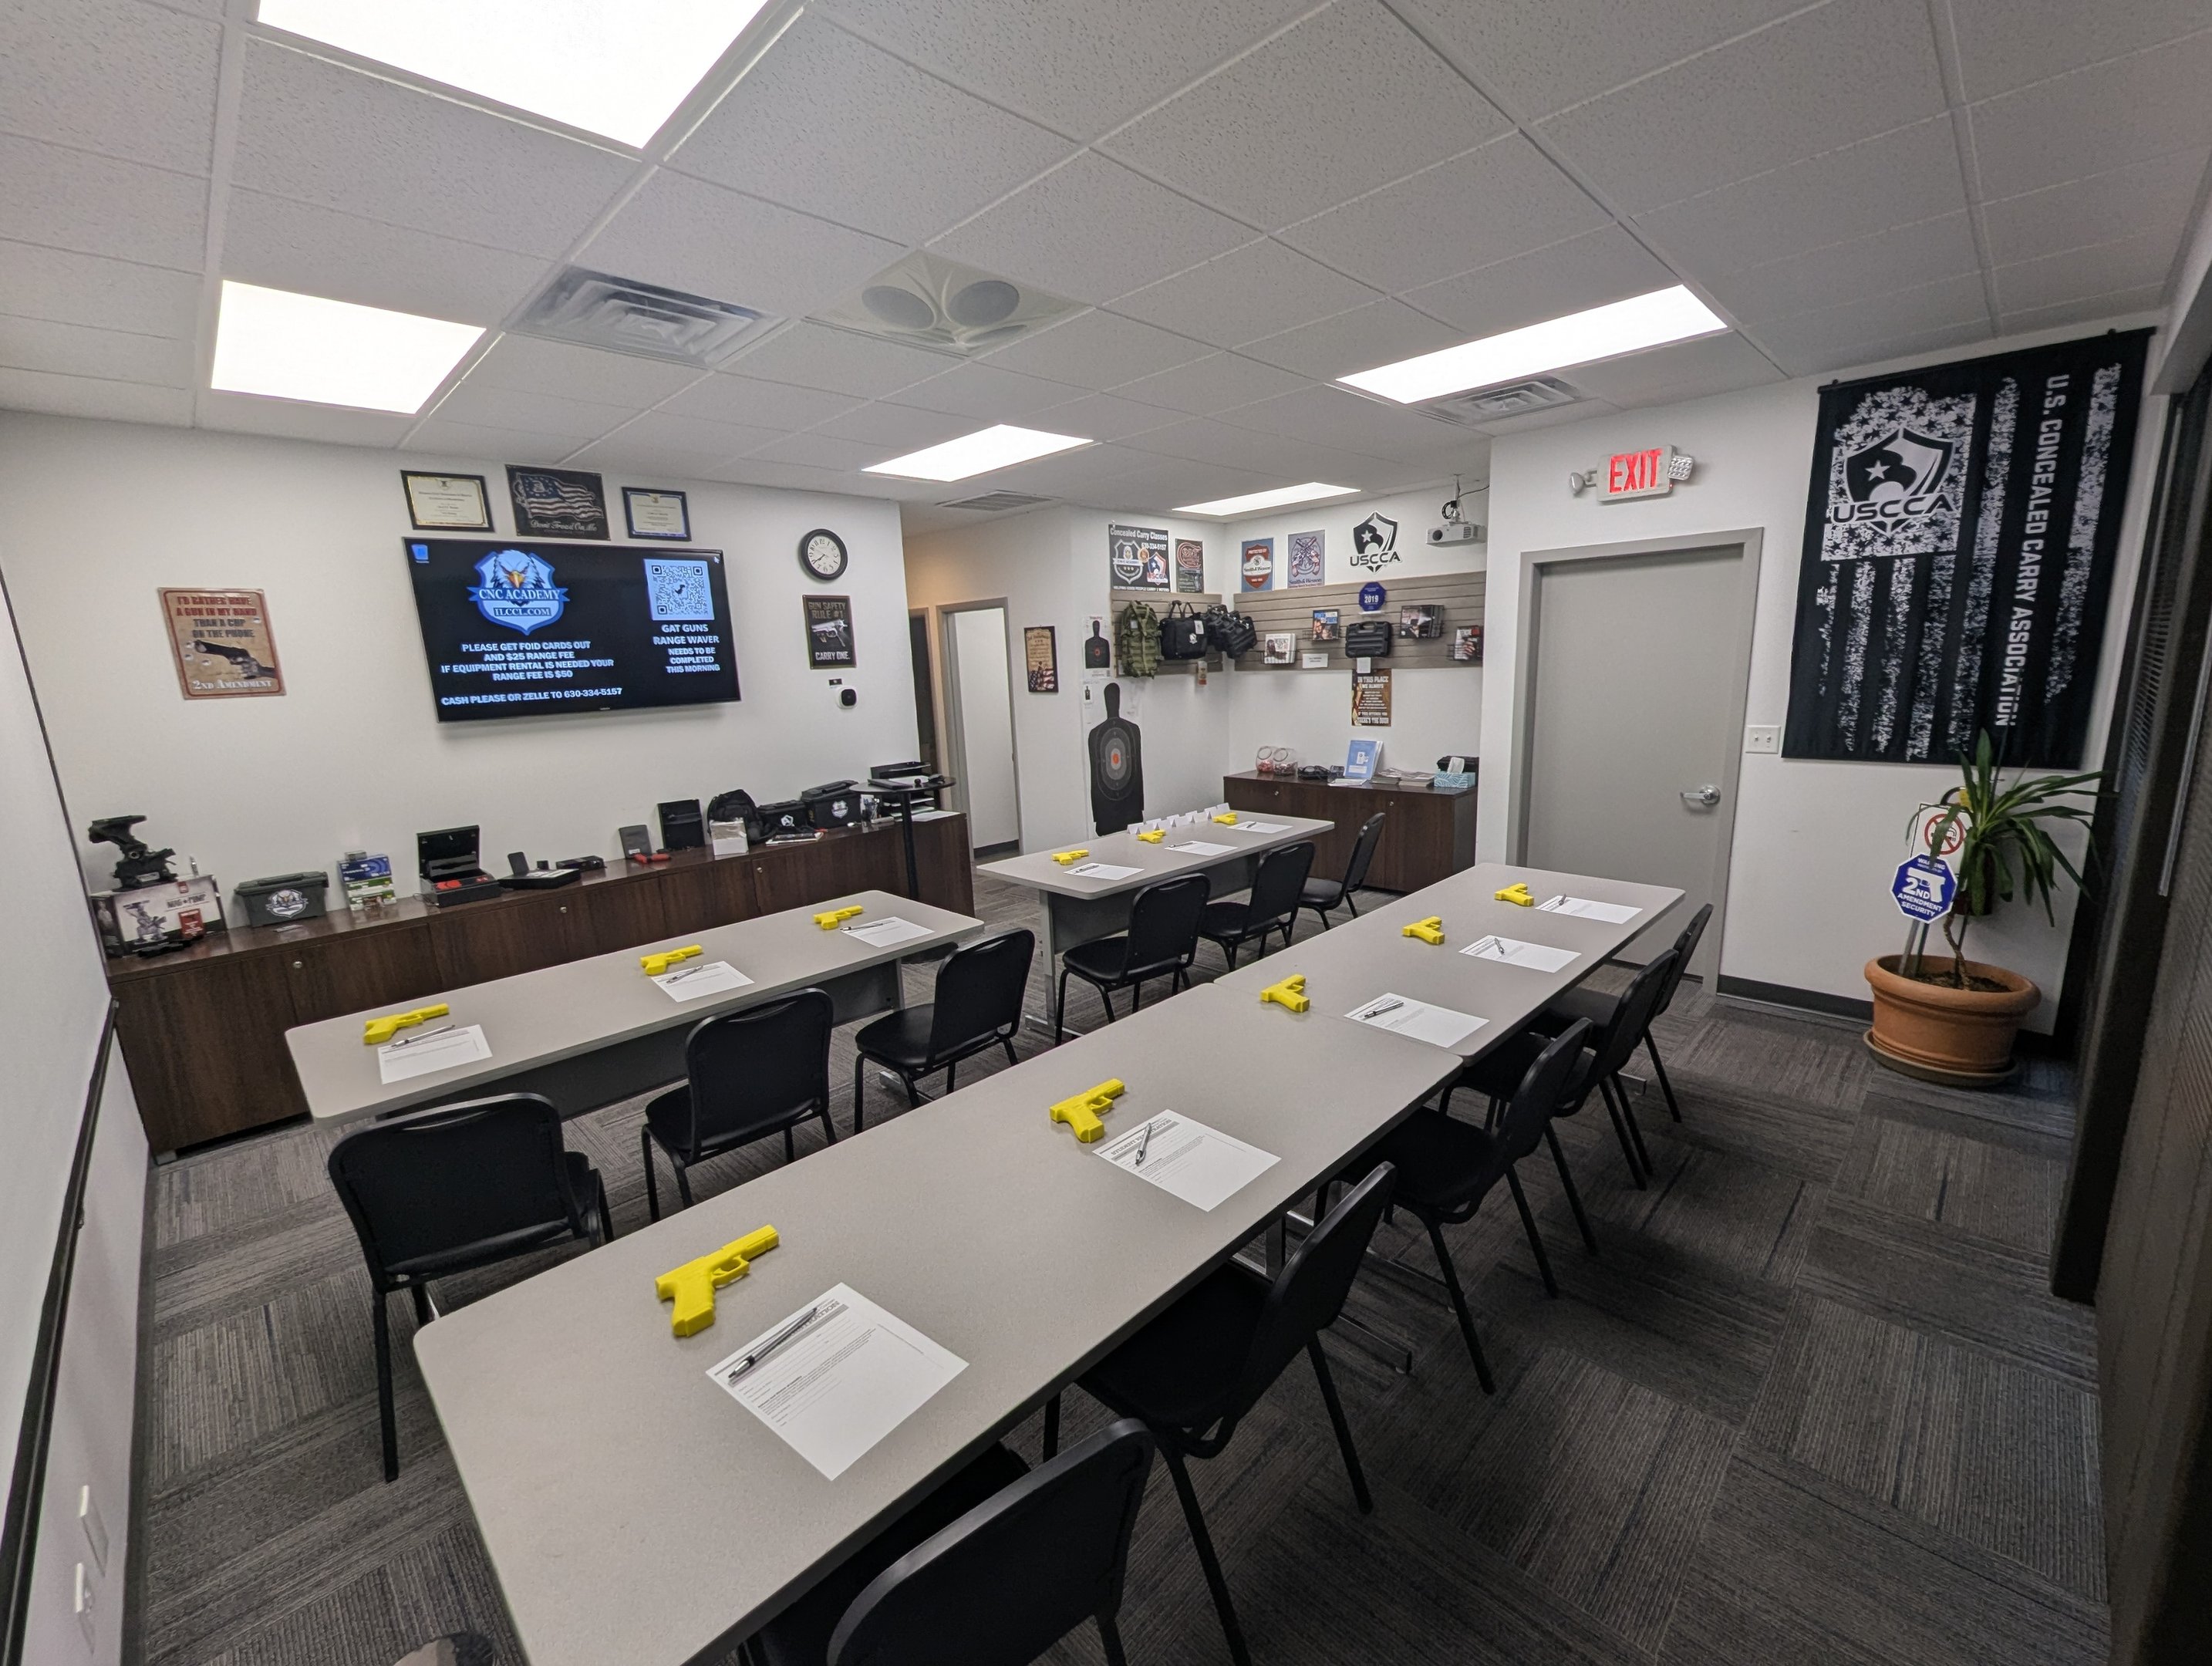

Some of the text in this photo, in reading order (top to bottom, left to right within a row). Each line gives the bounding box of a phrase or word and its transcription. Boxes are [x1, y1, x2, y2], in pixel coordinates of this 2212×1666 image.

[1610, 448, 1662, 494] EXIT
[1833, 494, 1953, 523] USCCA
[1111, 528, 1135, 537] Concealed
[1137, 531, 1149, 540] Carry
[1995, 374, 2070, 727] U.S. CONCEALED CARRY ASSOCIATION
[1350, 551, 1401, 566] USCCA
[479, 589, 560, 600] CNC ACADEMY
[822, 602, 845, 611] SAFETY
[811, 609, 844, 619] RULE #1
[193, 619, 217, 627] THAN
[682, 624, 709, 632] GUNS
[206, 629, 224, 638] THE
[461, 643, 498, 652] PLEASE
[500, 642, 518, 651] GET
[518, 642, 541, 650] FOID
[573, 640, 591, 649] OUT
[652, 636, 720, 645] RANGE WAVER
[484, 653, 504, 662] AND
[506, 653, 525, 661] $25
[526, 652, 558, 660] RANGE
[669, 656, 714, 665] COMPLETED
[815, 651, 850, 660] CARRY ONE.
[453, 663, 507, 673] EQUIPMENT
[509, 662, 545, 670] RENTAL
[591, 659, 614, 667] YOUR
[685, 664, 720, 673] MORNING
[555, 670, 573, 679] $50
[193, 680, 271, 690] 2ND AMENDMENT
[441, 696, 469, 705] CASH
[470, 694, 507, 703] PLEASE
[521, 692, 550, 700] ZELLE
[564, 687, 623, 698] 630-334-5157
[1917, 858, 1945, 870] WAING
[1902, 877, 1930, 899] 2ND
[1897, 893, 1944, 912] AMENDMENT
[1901, 901, 1936, 917] SECURITY
